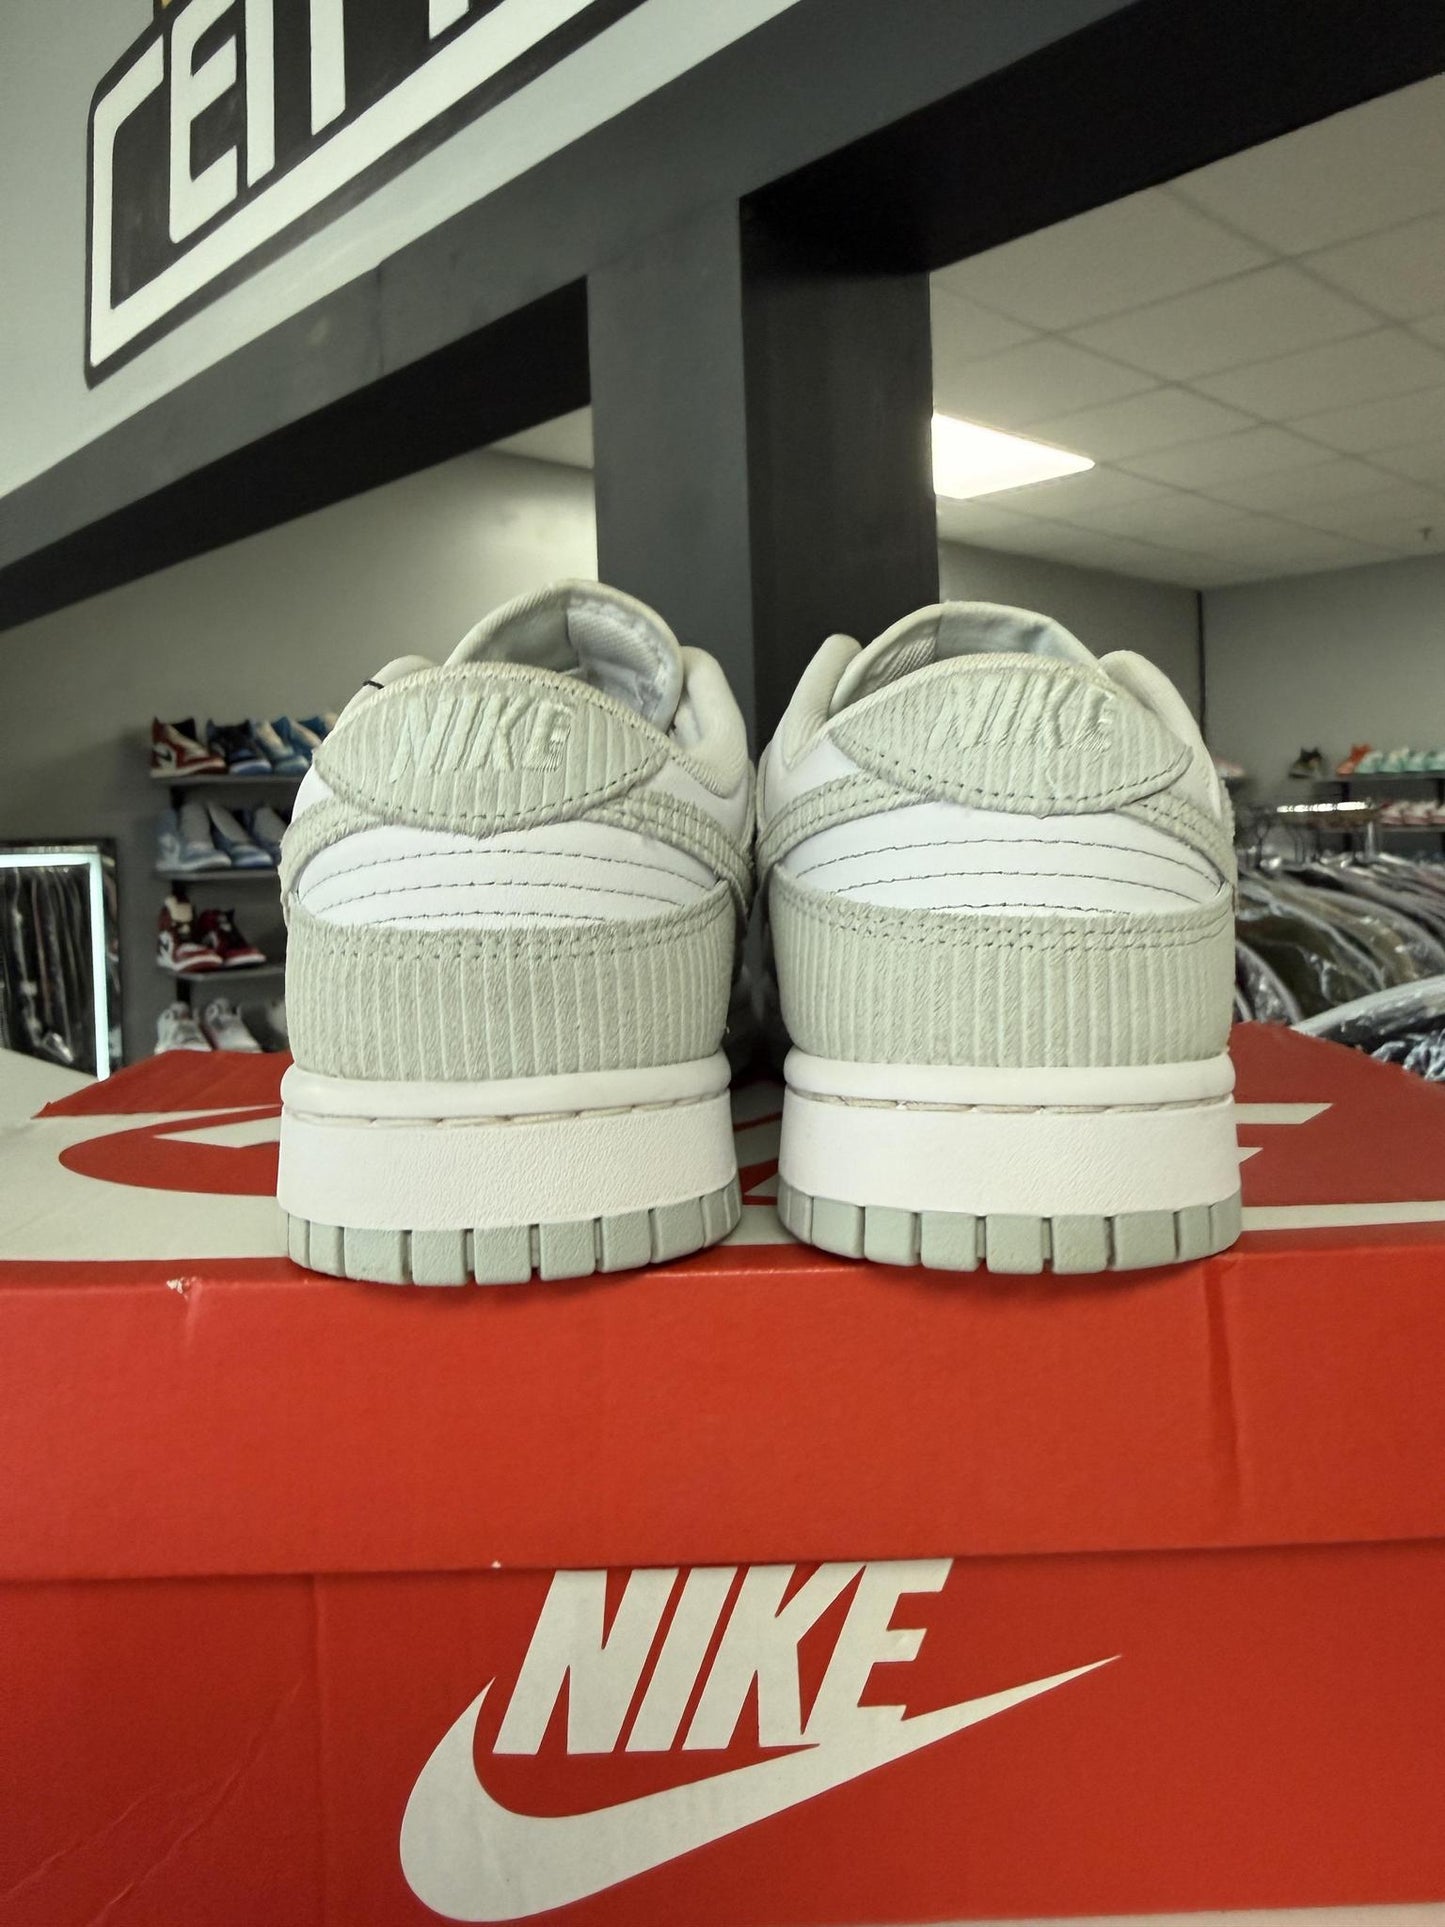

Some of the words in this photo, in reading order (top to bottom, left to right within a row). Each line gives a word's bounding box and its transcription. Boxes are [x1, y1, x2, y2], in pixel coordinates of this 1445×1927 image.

[390, 693, 572, 783] NIKE
[927, 671, 1115, 752] NIKE
[492, 1558, 954, 1756] NIKE
